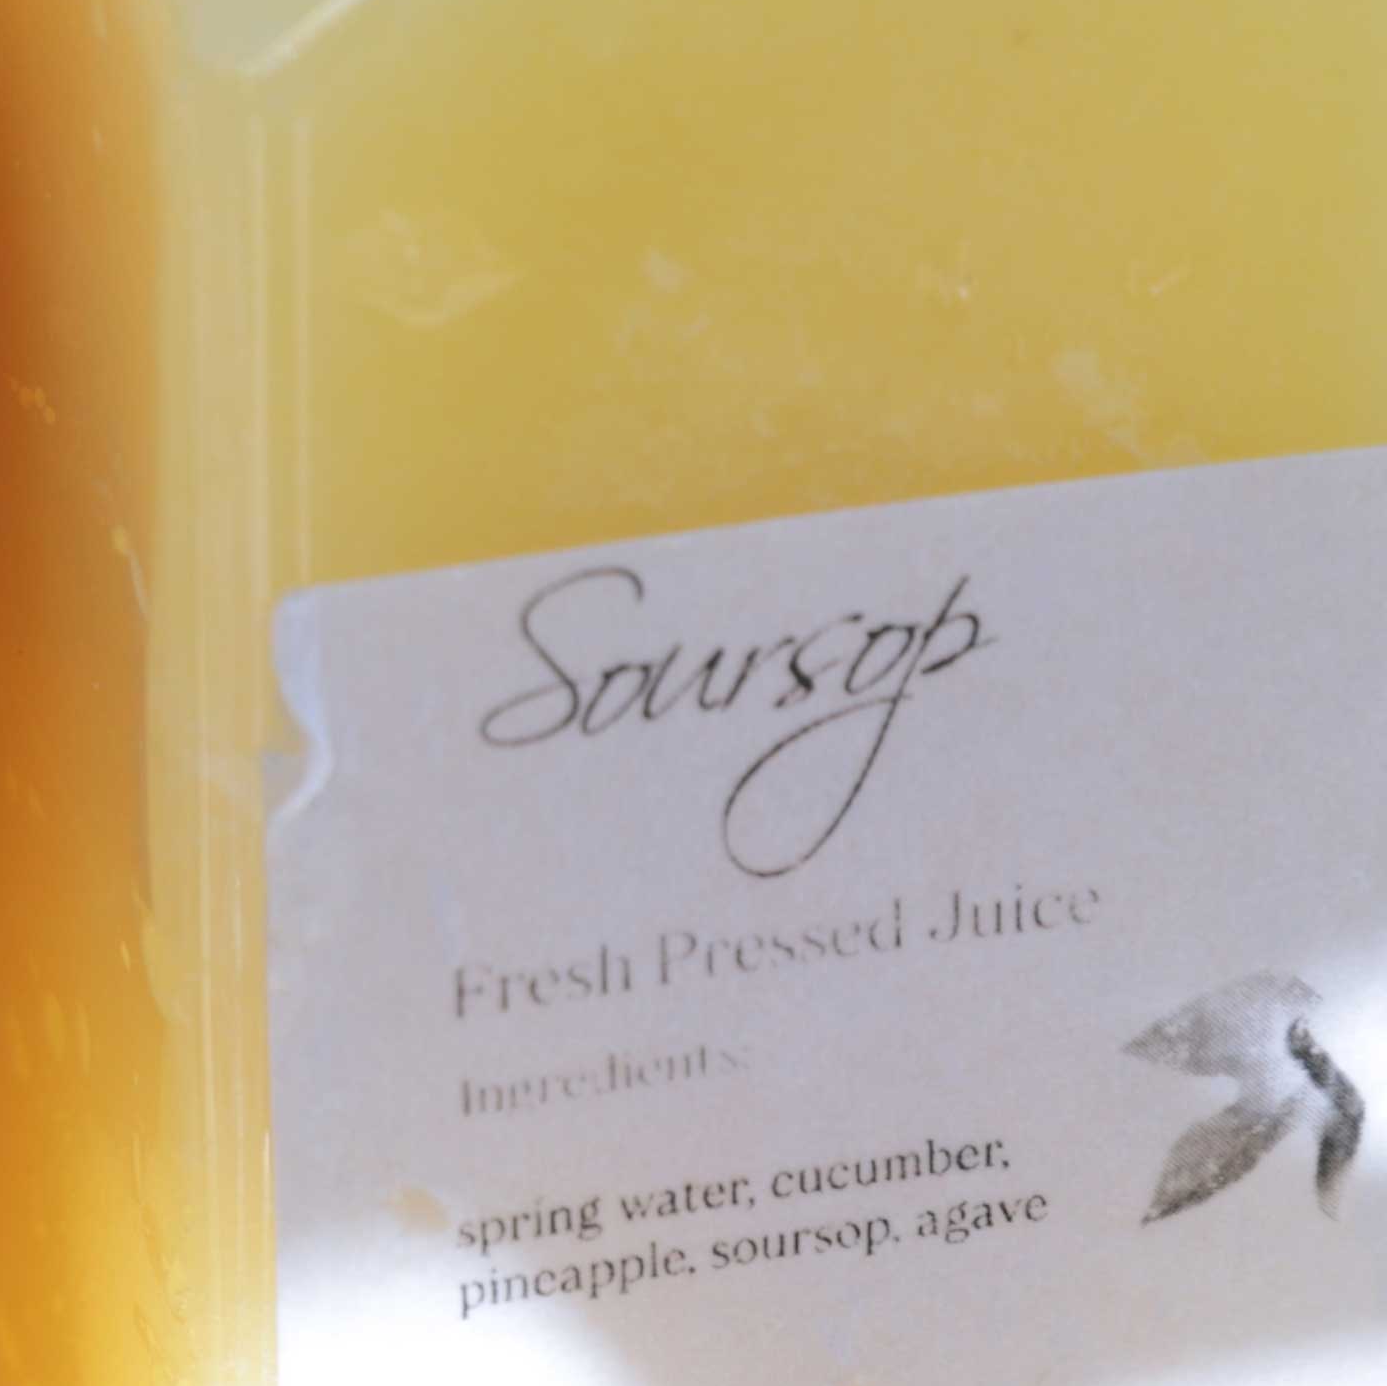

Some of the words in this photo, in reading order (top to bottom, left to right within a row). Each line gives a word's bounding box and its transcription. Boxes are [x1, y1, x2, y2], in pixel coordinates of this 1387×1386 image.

[479, 565, 997, 878] Soursop
[453, 944, 632, 1019] Fresh
[657, 899, 904, 986] Pressed
[928, 883, 1101, 941] Juice
[456, 1197, 604, 1257] spring
[618, 1176, 756, 1223] water,
[771, 1139, 1011, 1200] cucumber,
[459, 1247, 698, 1319] pineapple,
[710, 1217, 901, 1270] soursop,
[916, 1192, 1049, 1242] agave
